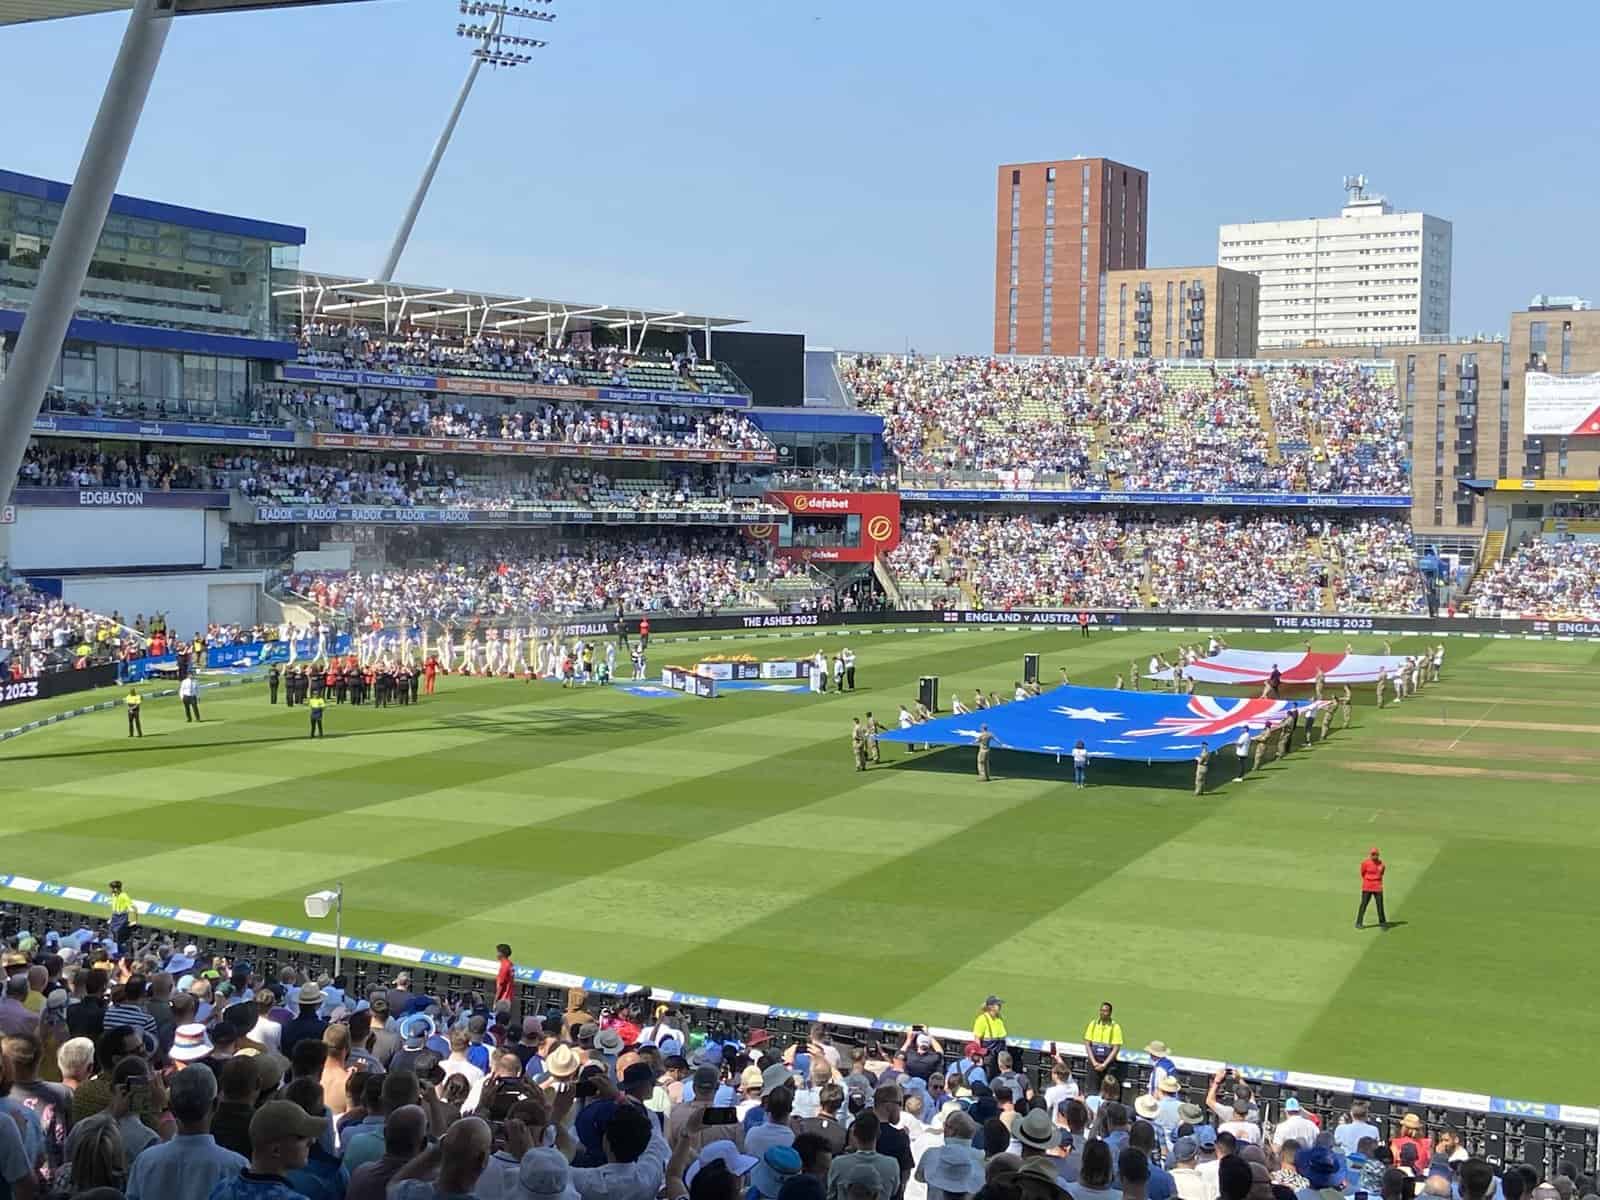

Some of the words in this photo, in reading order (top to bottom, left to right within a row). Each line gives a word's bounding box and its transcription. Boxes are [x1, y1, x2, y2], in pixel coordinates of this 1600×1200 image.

[80, 492, 143, 505] EDGBASTON
[808, 497, 849, 509] dafabet
[261, 509, 292, 521] RADOX
[307, 509, 337, 521] RADOX
[351, 509, 382, 521] RADOX
[396, 509, 425, 521] RADOX
[439, 510, 470, 521] RADOX
[743, 616, 761, 627] THE
[763, 616, 793, 627] ASHES
[795, 615, 818, 625] 2023
[965, 612, 1021, 622] ENGLAND
[1032, 613, 1098, 624] AUSTRAIA
[1274, 617, 1298, 627] THE
[1301, 617, 1340, 628] ASHES
[1343, 619, 1373, 629] 2023
[560, 624, 608, 637] USTRALIA
[5, 681, 39, 700] 2023
[1367, 1082, 1405, 1097] LV=
[1504, 1100, 1545, 1116] LV=
